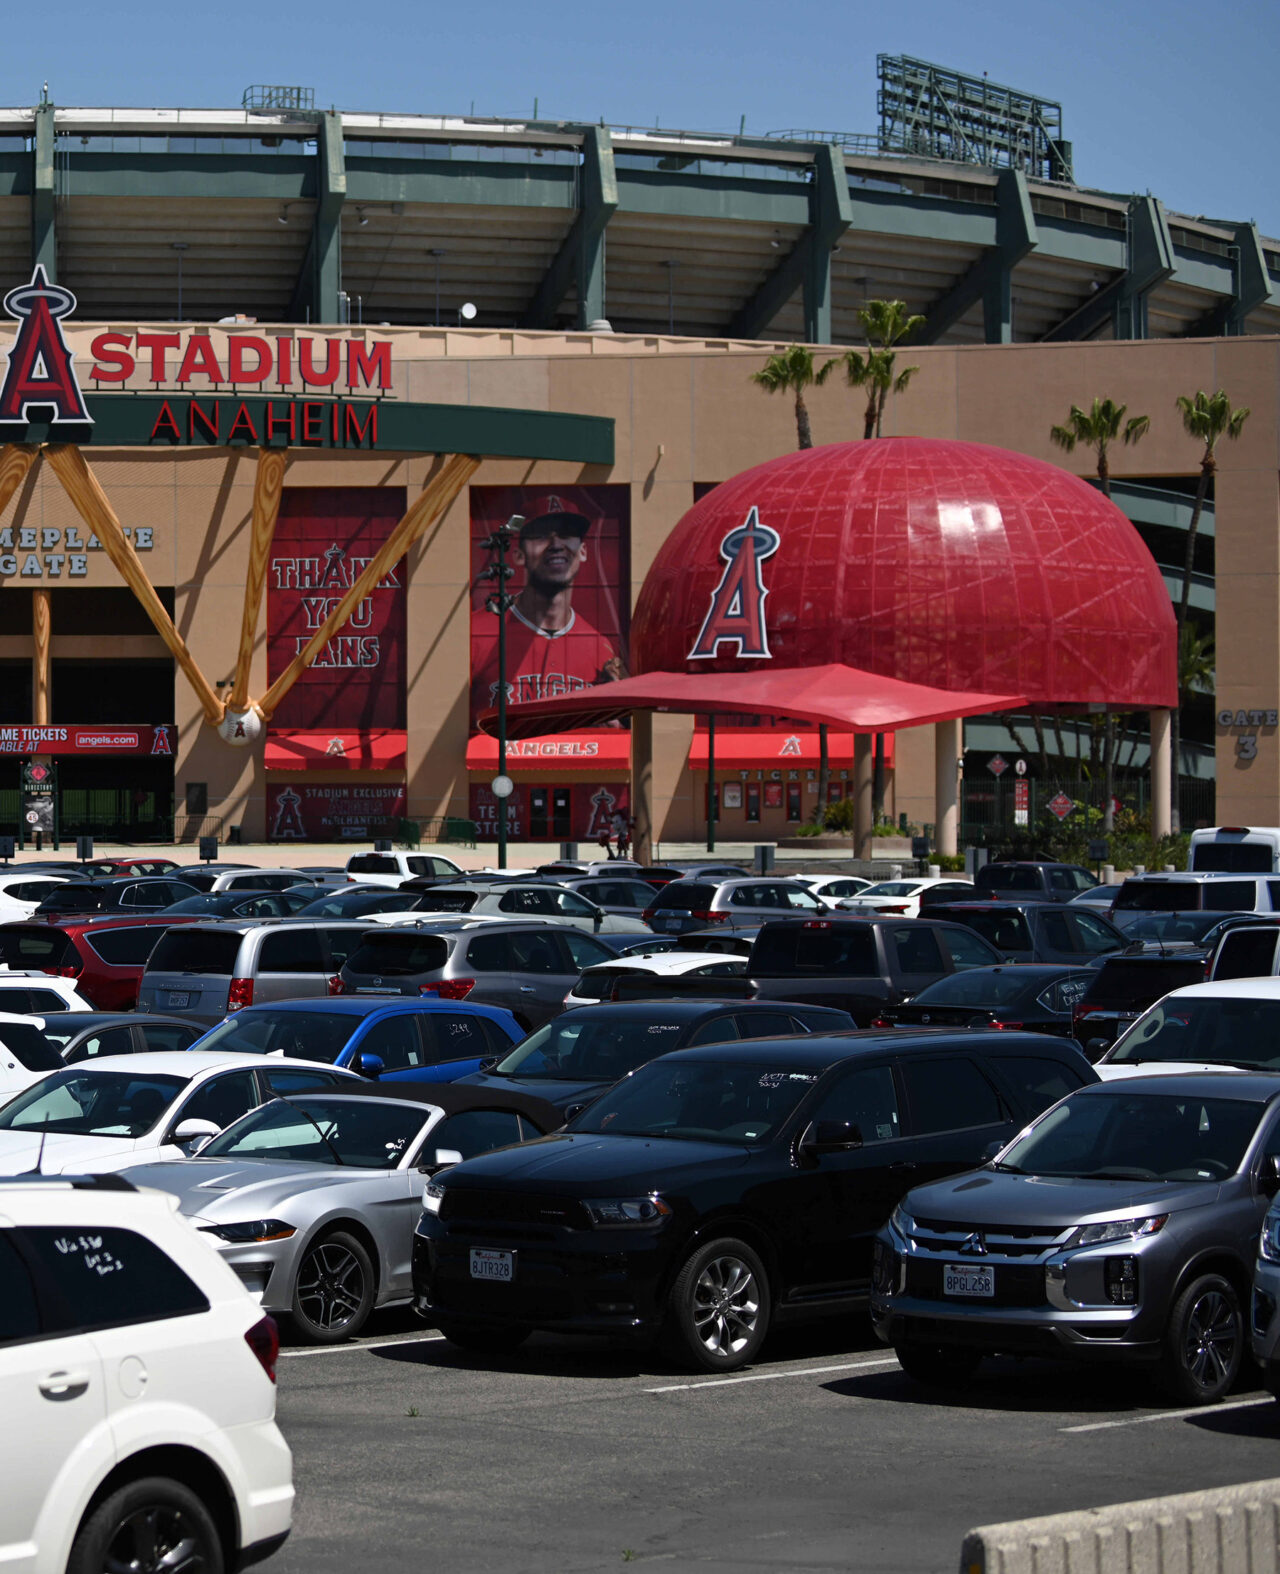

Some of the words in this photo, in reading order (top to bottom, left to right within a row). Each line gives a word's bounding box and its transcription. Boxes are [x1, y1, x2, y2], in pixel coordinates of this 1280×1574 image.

[89, 331, 393, 390] STADIUM
[150, 400, 378, 443] ANAHEIM
[686, 505, 773, 660] A
[1218, 709, 1279, 727] GATE
[22, 729, 67, 741] TICKETS
[79, 736, 135, 745] angels.com
[26, 742, 39, 752] AT
[1238, 735, 1257, 759] 3
[306, 788, 349, 798] STADIUM
[353, 788, 403, 798] EXCLUSIVE
[472, 1260, 510, 1277] 8JTR328
[946, 1275, 991, 1292] 8PGL258
